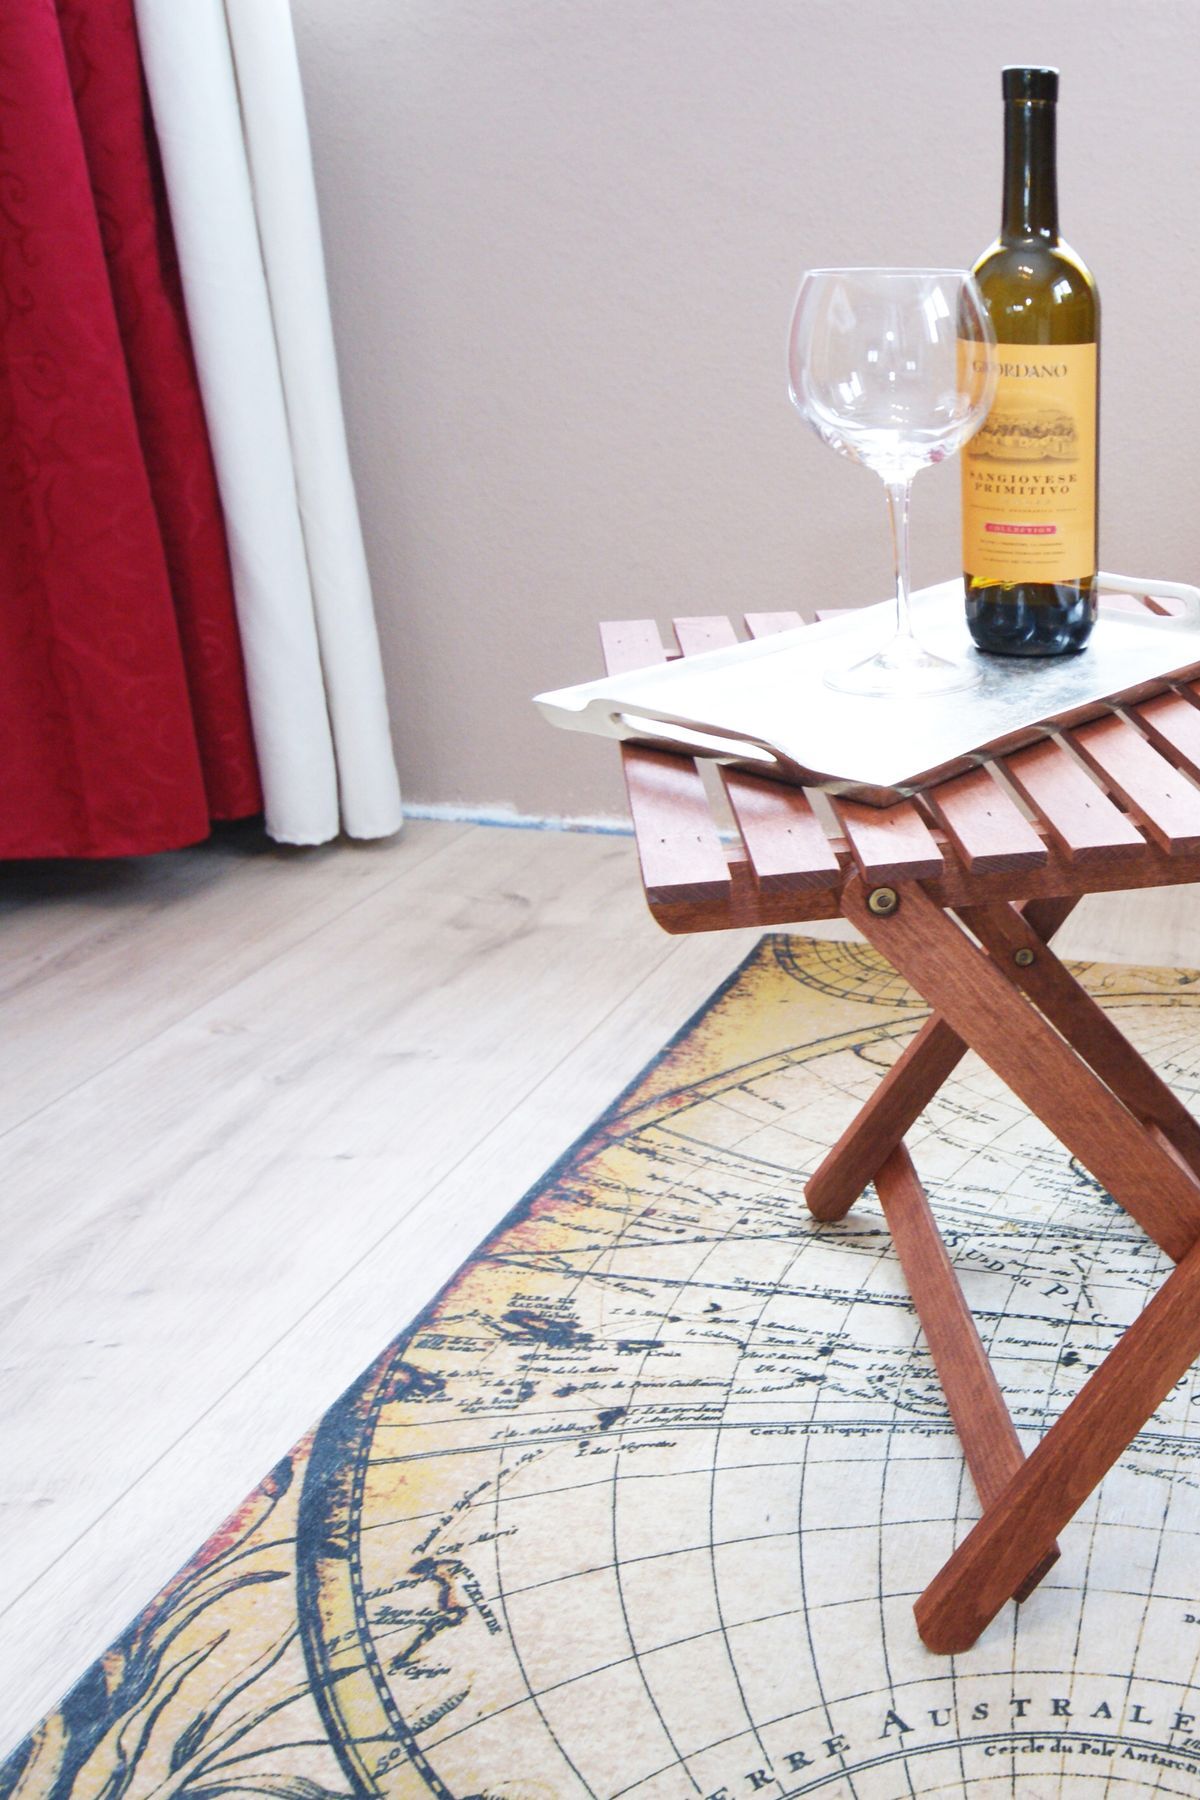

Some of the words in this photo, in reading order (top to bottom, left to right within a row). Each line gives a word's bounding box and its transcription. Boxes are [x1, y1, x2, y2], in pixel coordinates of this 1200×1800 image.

[969, 470, 1077, 484] SANGIOVESE
[974, 482, 1070, 495] PRIMITIVO
[750, 1424, 799, 1436] Cercle
[802, 1424, 819, 1435] du
[822, 1424, 883, 1437] Tropique
[889, 1424, 907, 1435] du
[878, 1697, 1197, 1740] AUSTRALE
[984, 1738, 1045, 1757] Cercle
[1050, 1738, 1074, 1755] du
[1077, 1741, 1116, 1758] Pole
